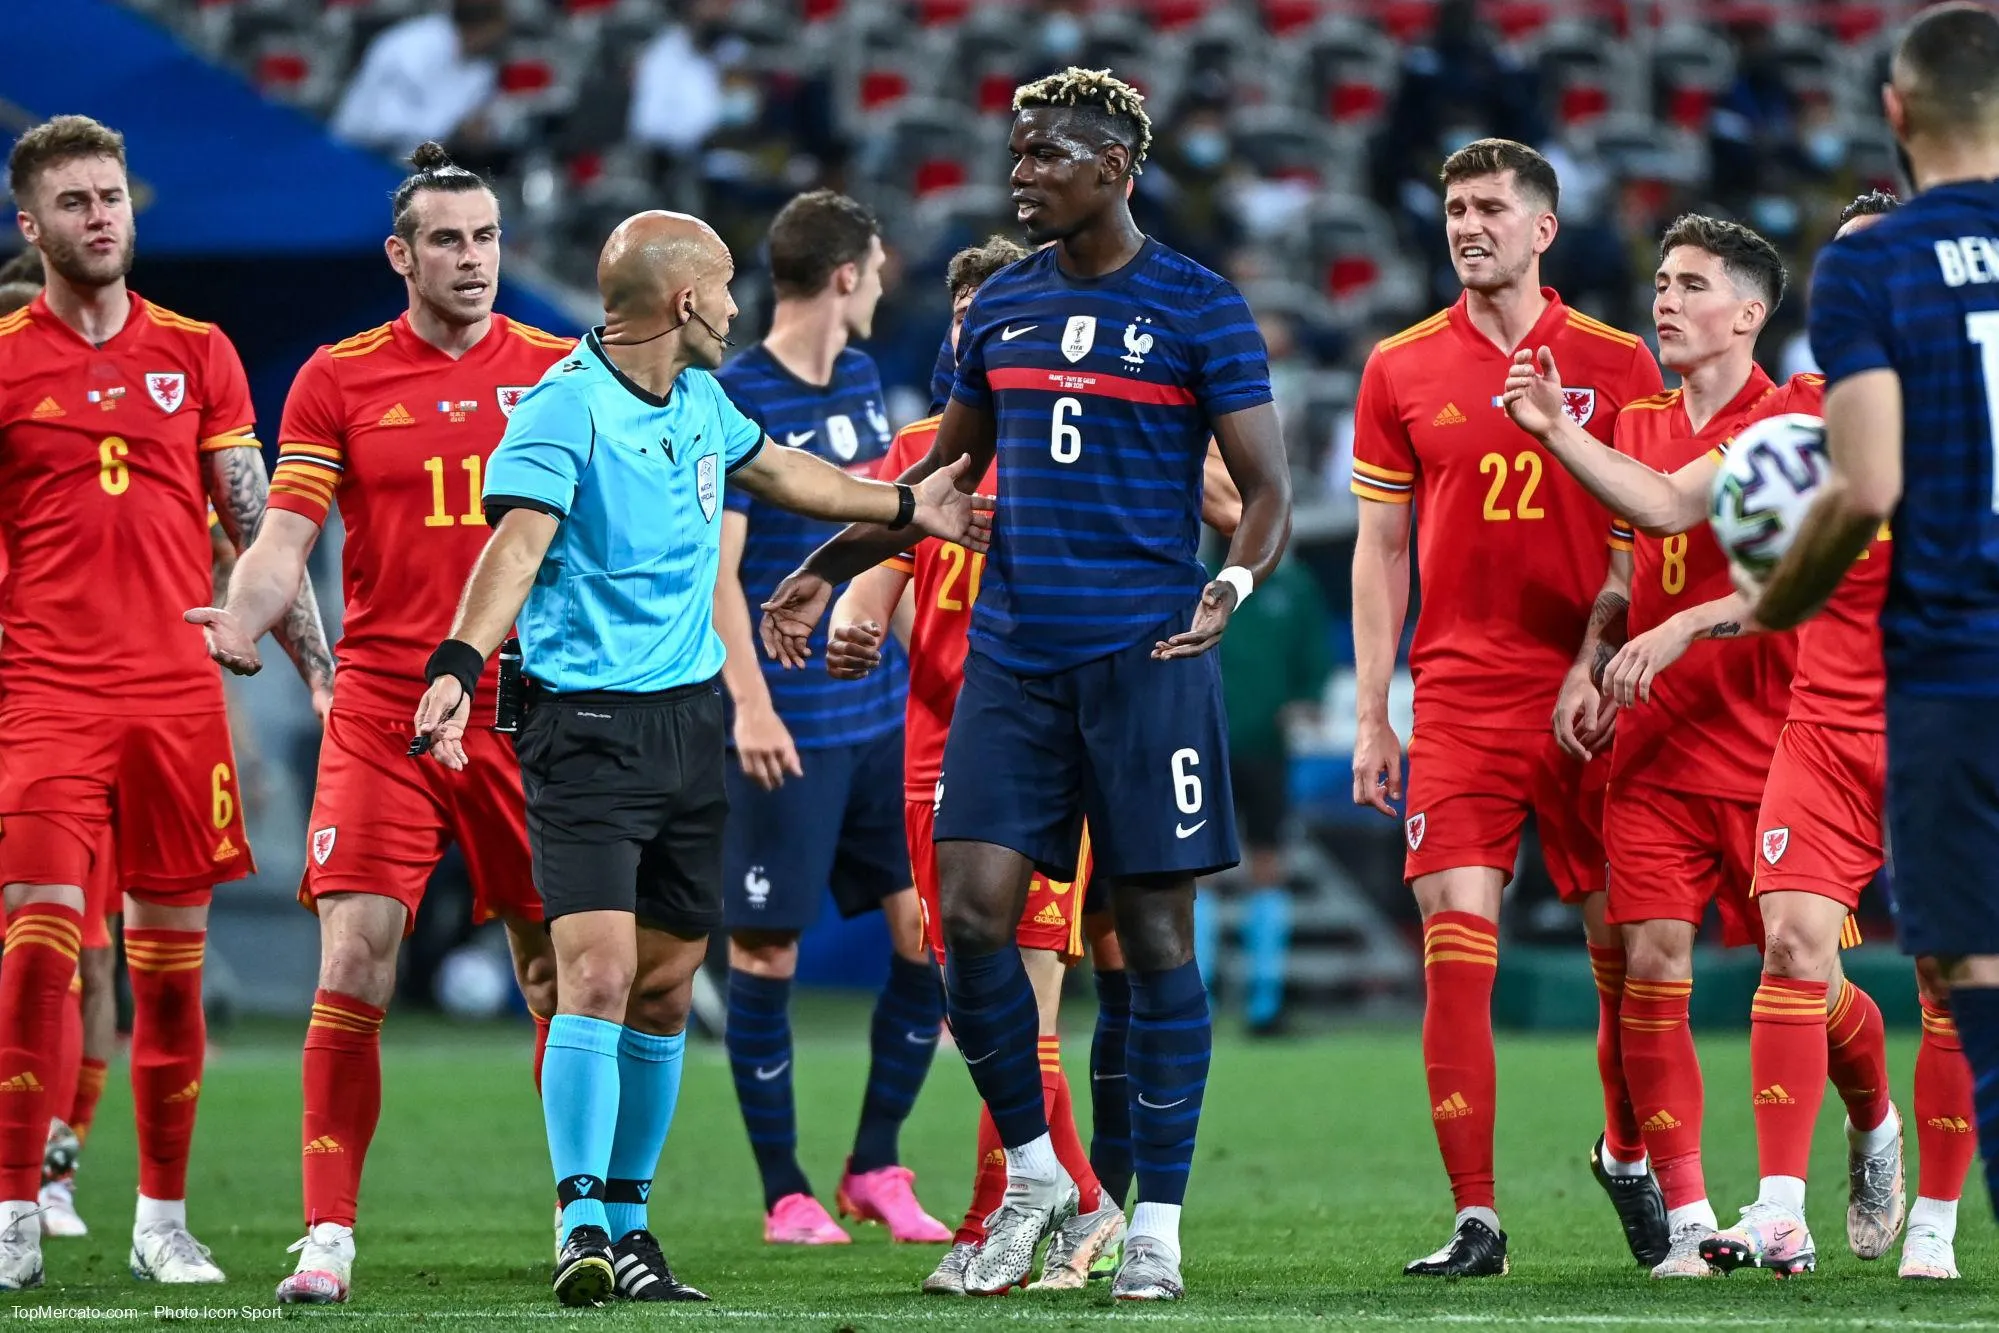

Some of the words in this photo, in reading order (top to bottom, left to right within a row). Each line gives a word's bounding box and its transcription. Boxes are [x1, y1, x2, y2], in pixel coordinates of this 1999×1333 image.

[1050, 397, 1082, 464] 6
[1433, 416, 1467, 427] adidas
[99, 436, 129, 496] 6
[424, 454, 488, 527] 11
[1479, 451, 1545, 521] 22
[1662, 531, 1688, 595] 8
[211, 762, 233, 829] 6
[1171, 747, 1202, 814] 6
[1033, 915, 1066, 926] adidas
[1433, 1107, 1473, 1120] adidas
[1641, 1120, 1682, 1131] adidas
[1752, 1097, 1796, 1105] adidas
